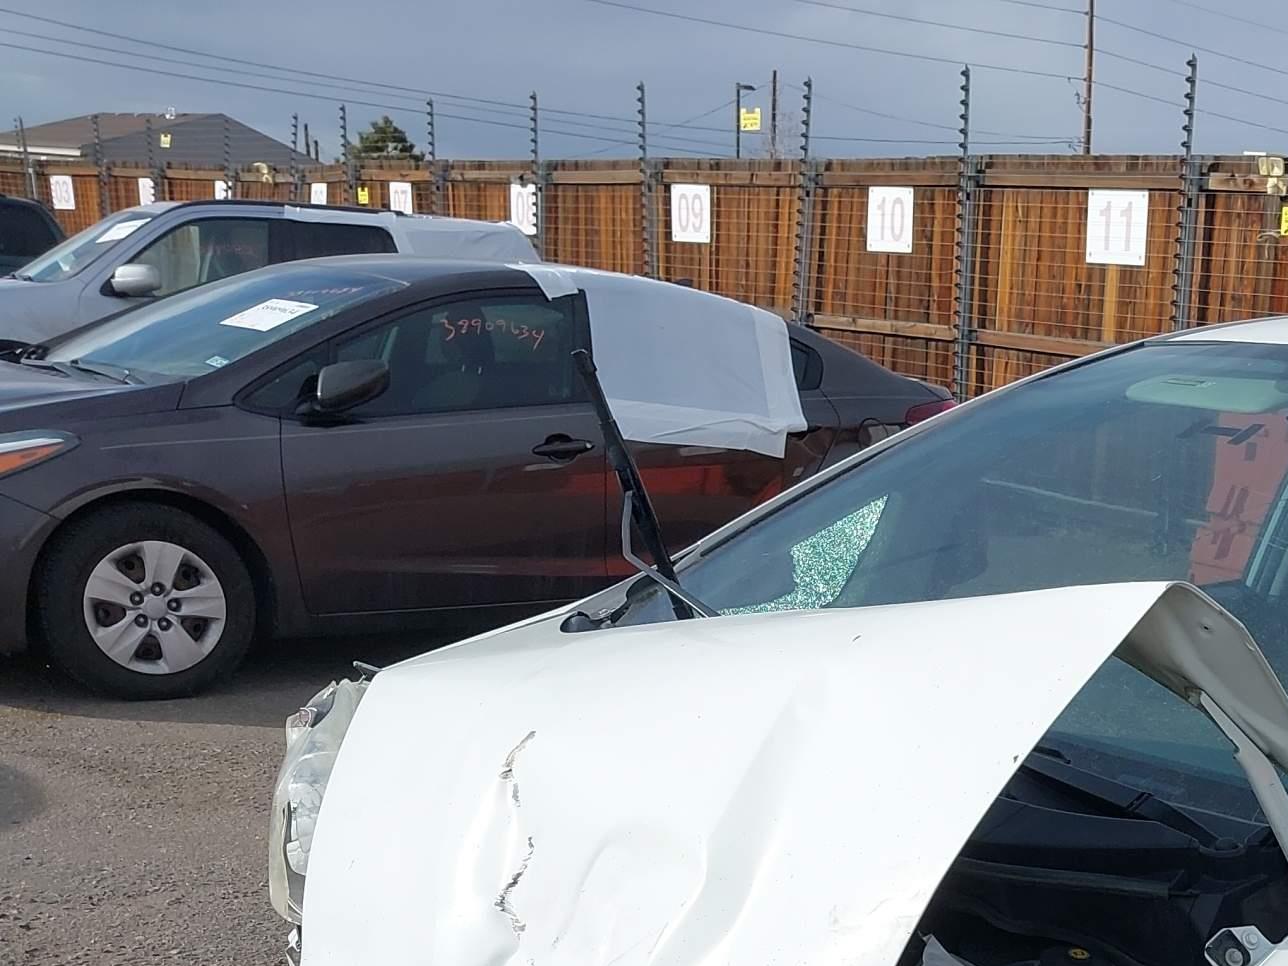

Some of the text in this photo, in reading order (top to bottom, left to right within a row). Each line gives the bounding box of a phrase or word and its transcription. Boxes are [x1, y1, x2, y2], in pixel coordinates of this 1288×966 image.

[54, 180, 71, 203] 03
[678, 193, 704, 233] 09
[876, 196, 905, 242] 10
[1098, 200, 1133, 252] 11
